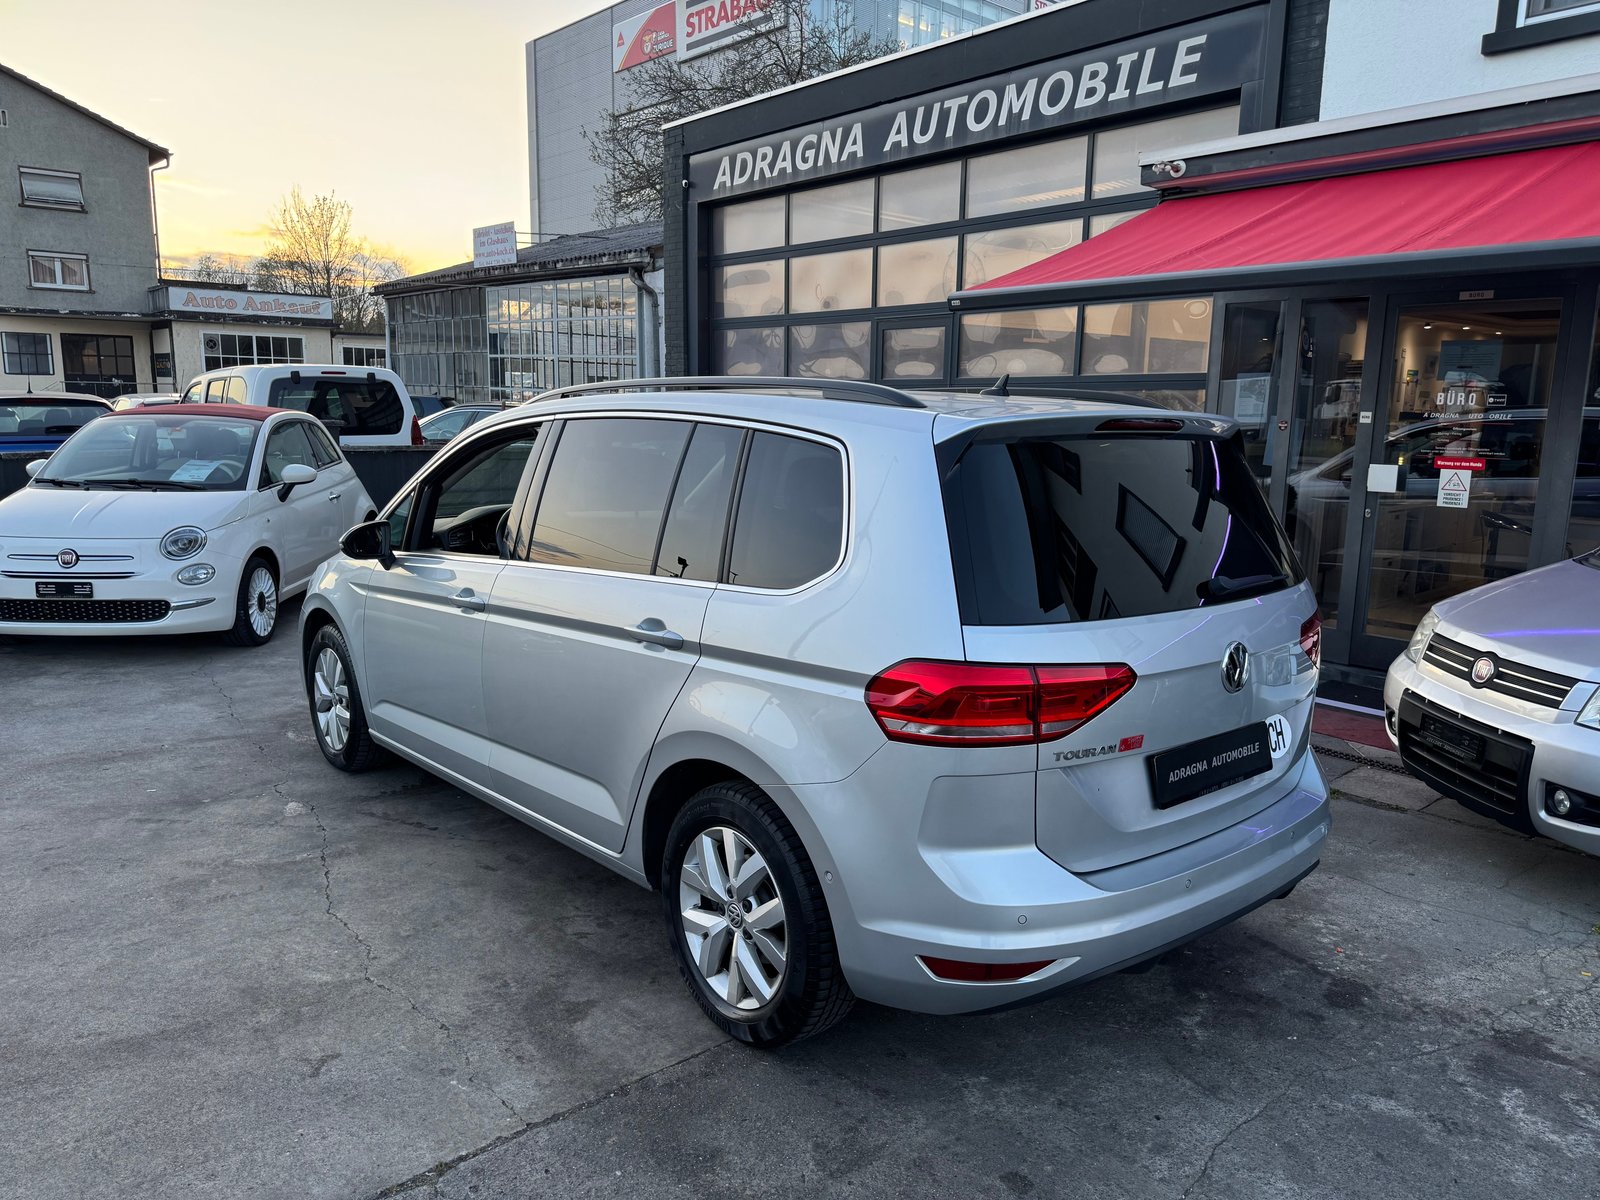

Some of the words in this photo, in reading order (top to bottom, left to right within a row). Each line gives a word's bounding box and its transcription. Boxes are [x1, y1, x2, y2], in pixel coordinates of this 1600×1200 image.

[713, 122, 864, 190] ADRAGNA
[883, 34, 1208, 152] AUTOMOBILE
[182, 292, 238, 310] Auto
[243, 296, 321, 315] Ankauf
[1436, 390, 1477, 406] BÜRO
[62, 554, 72, 562] FIAT
[1476, 664, 1490, 677] FIAT
[1268, 719, 1286, 752] CH
[1053, 744, 1117, 762] TOURAN
[1168, 759, 1208, 784] ADRAGNA
[1211, 742, 1260, 767] AUTOMOBILE
